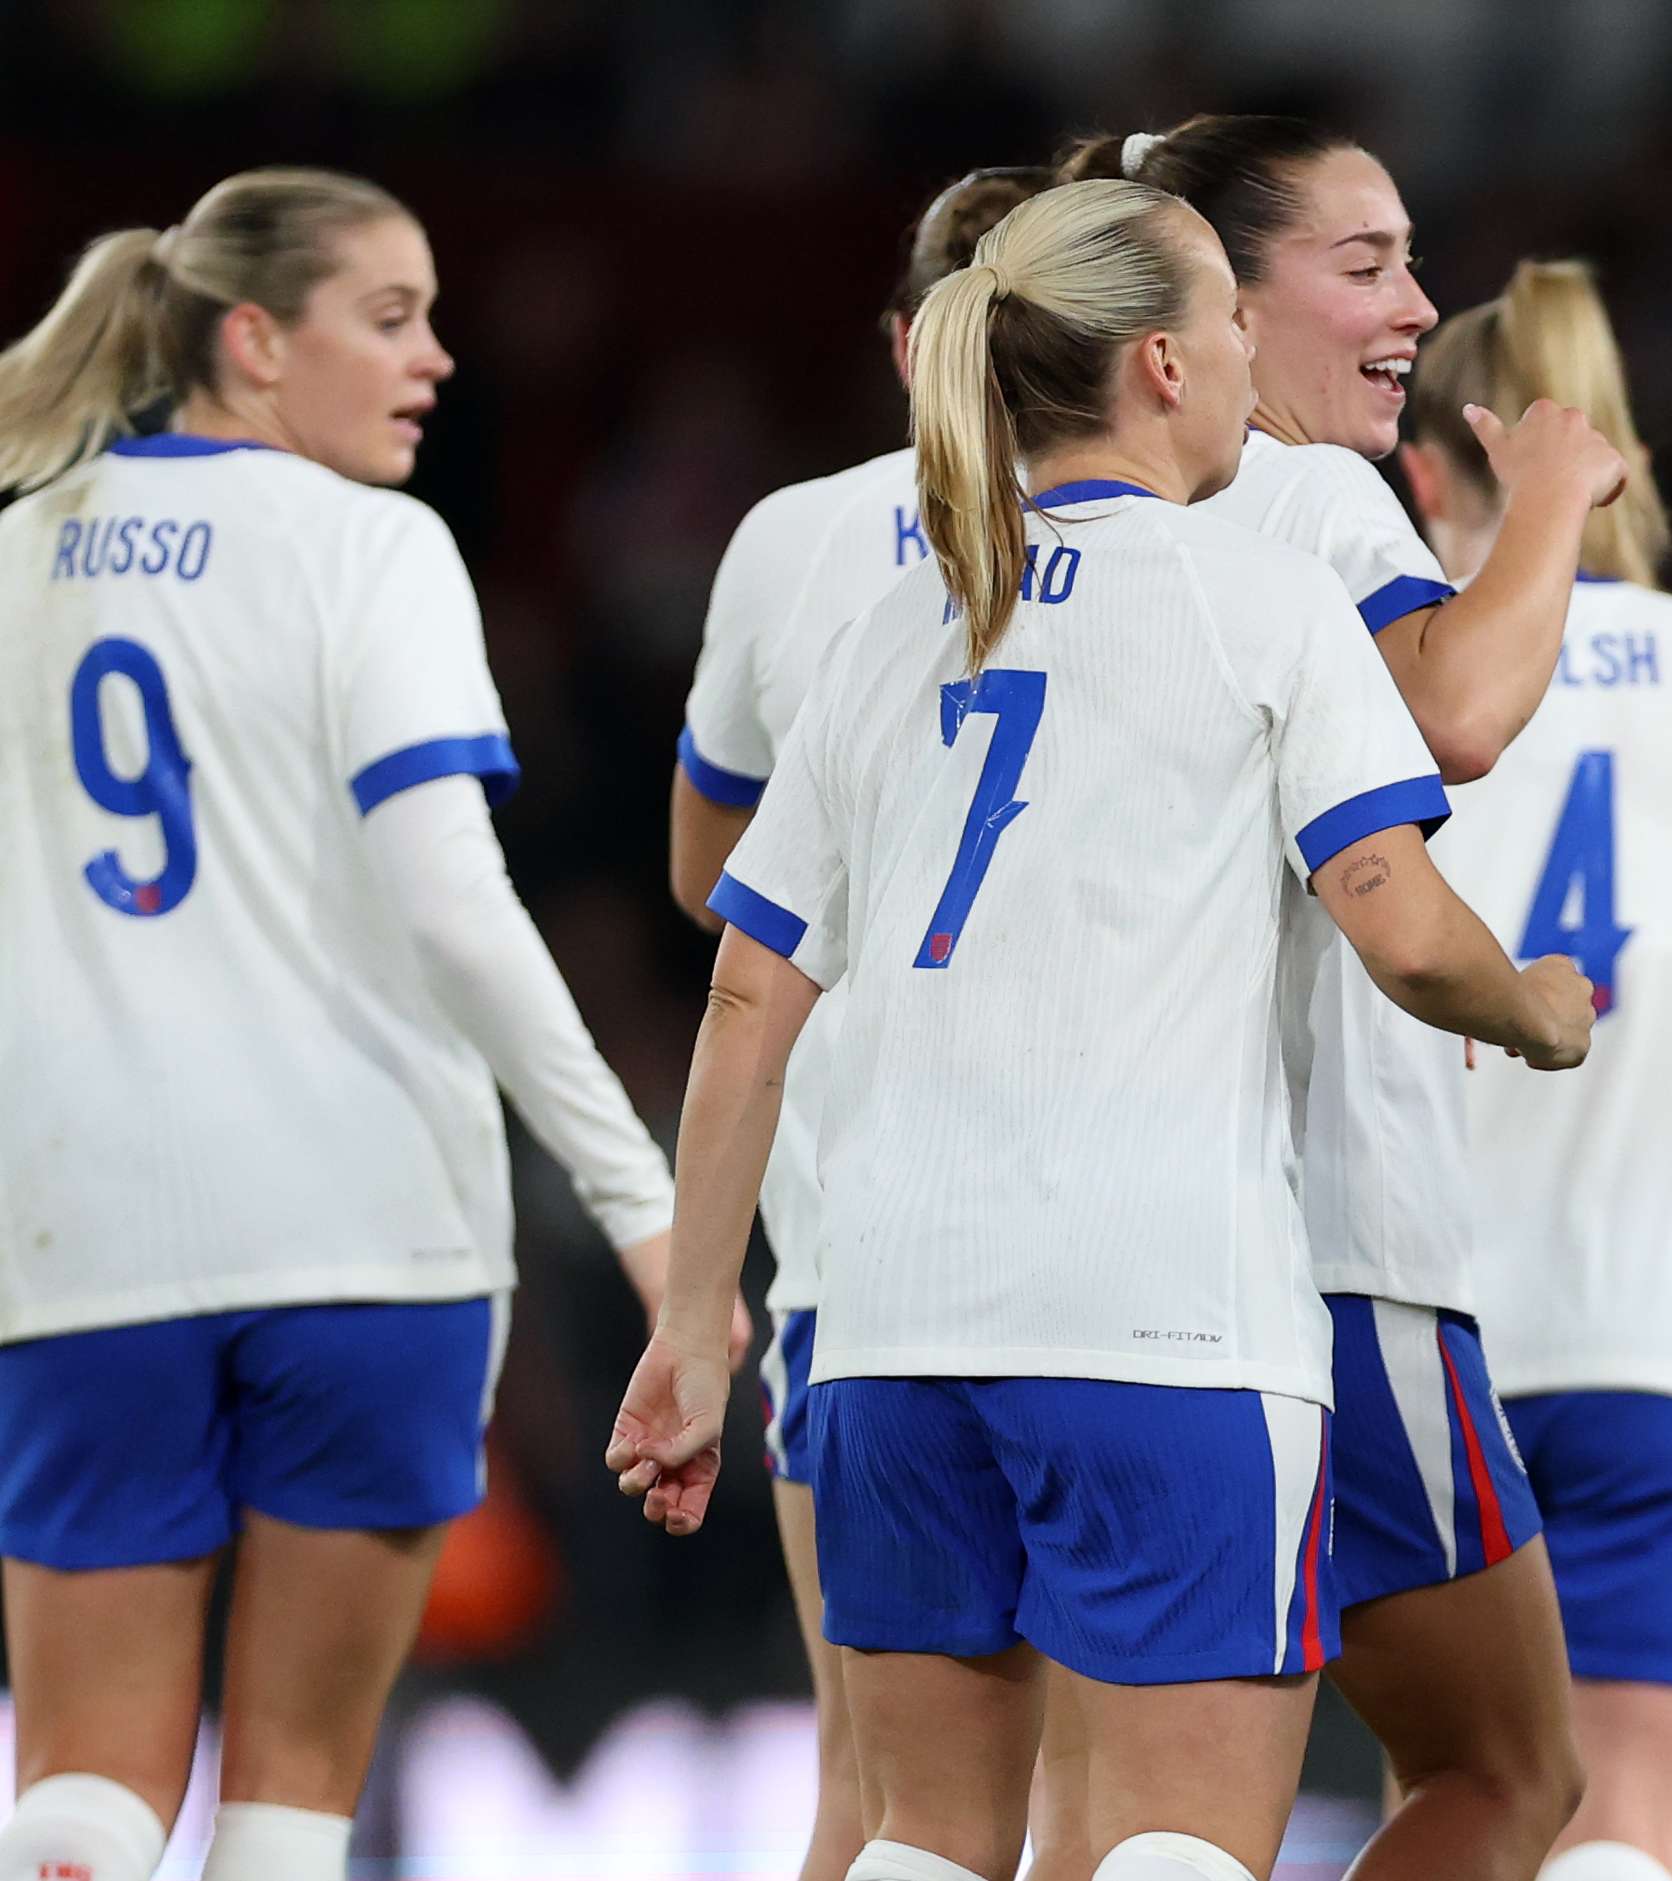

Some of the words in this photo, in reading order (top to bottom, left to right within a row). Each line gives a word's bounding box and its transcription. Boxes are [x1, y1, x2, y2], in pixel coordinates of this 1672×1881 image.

[52, 519, 212, 582] RUSSO
[71, 635, 197, 917] 9
[912, 668, 1048, 969] 7
[1518, 748, 1637, 1021] 4
